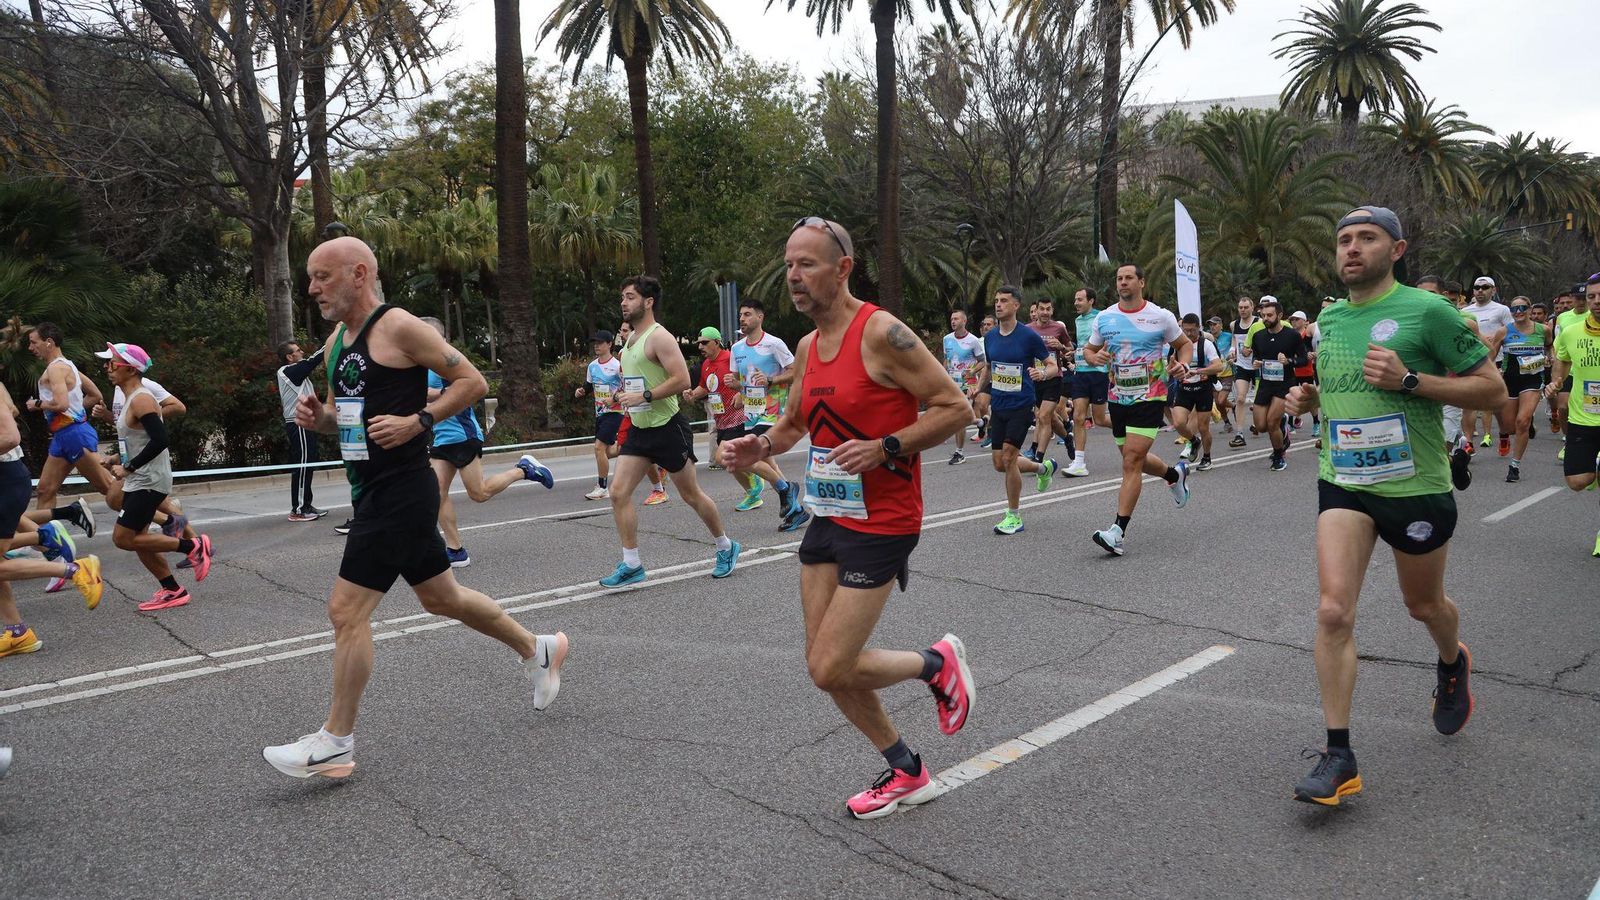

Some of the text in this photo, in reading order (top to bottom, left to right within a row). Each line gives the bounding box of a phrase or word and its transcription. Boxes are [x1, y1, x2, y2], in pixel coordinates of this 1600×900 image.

[338, 352, 367, 372] HASTINGS
[997, 375, 1017, 384] 2029
[1121, 377, 1144, 387] 4030
[338, 380, 366, 396] RUNNERS
[1591, 396, 1600, 405] 3
[1352, 448, 1392, 468] 354
[817, 482, 848, 500] 699
